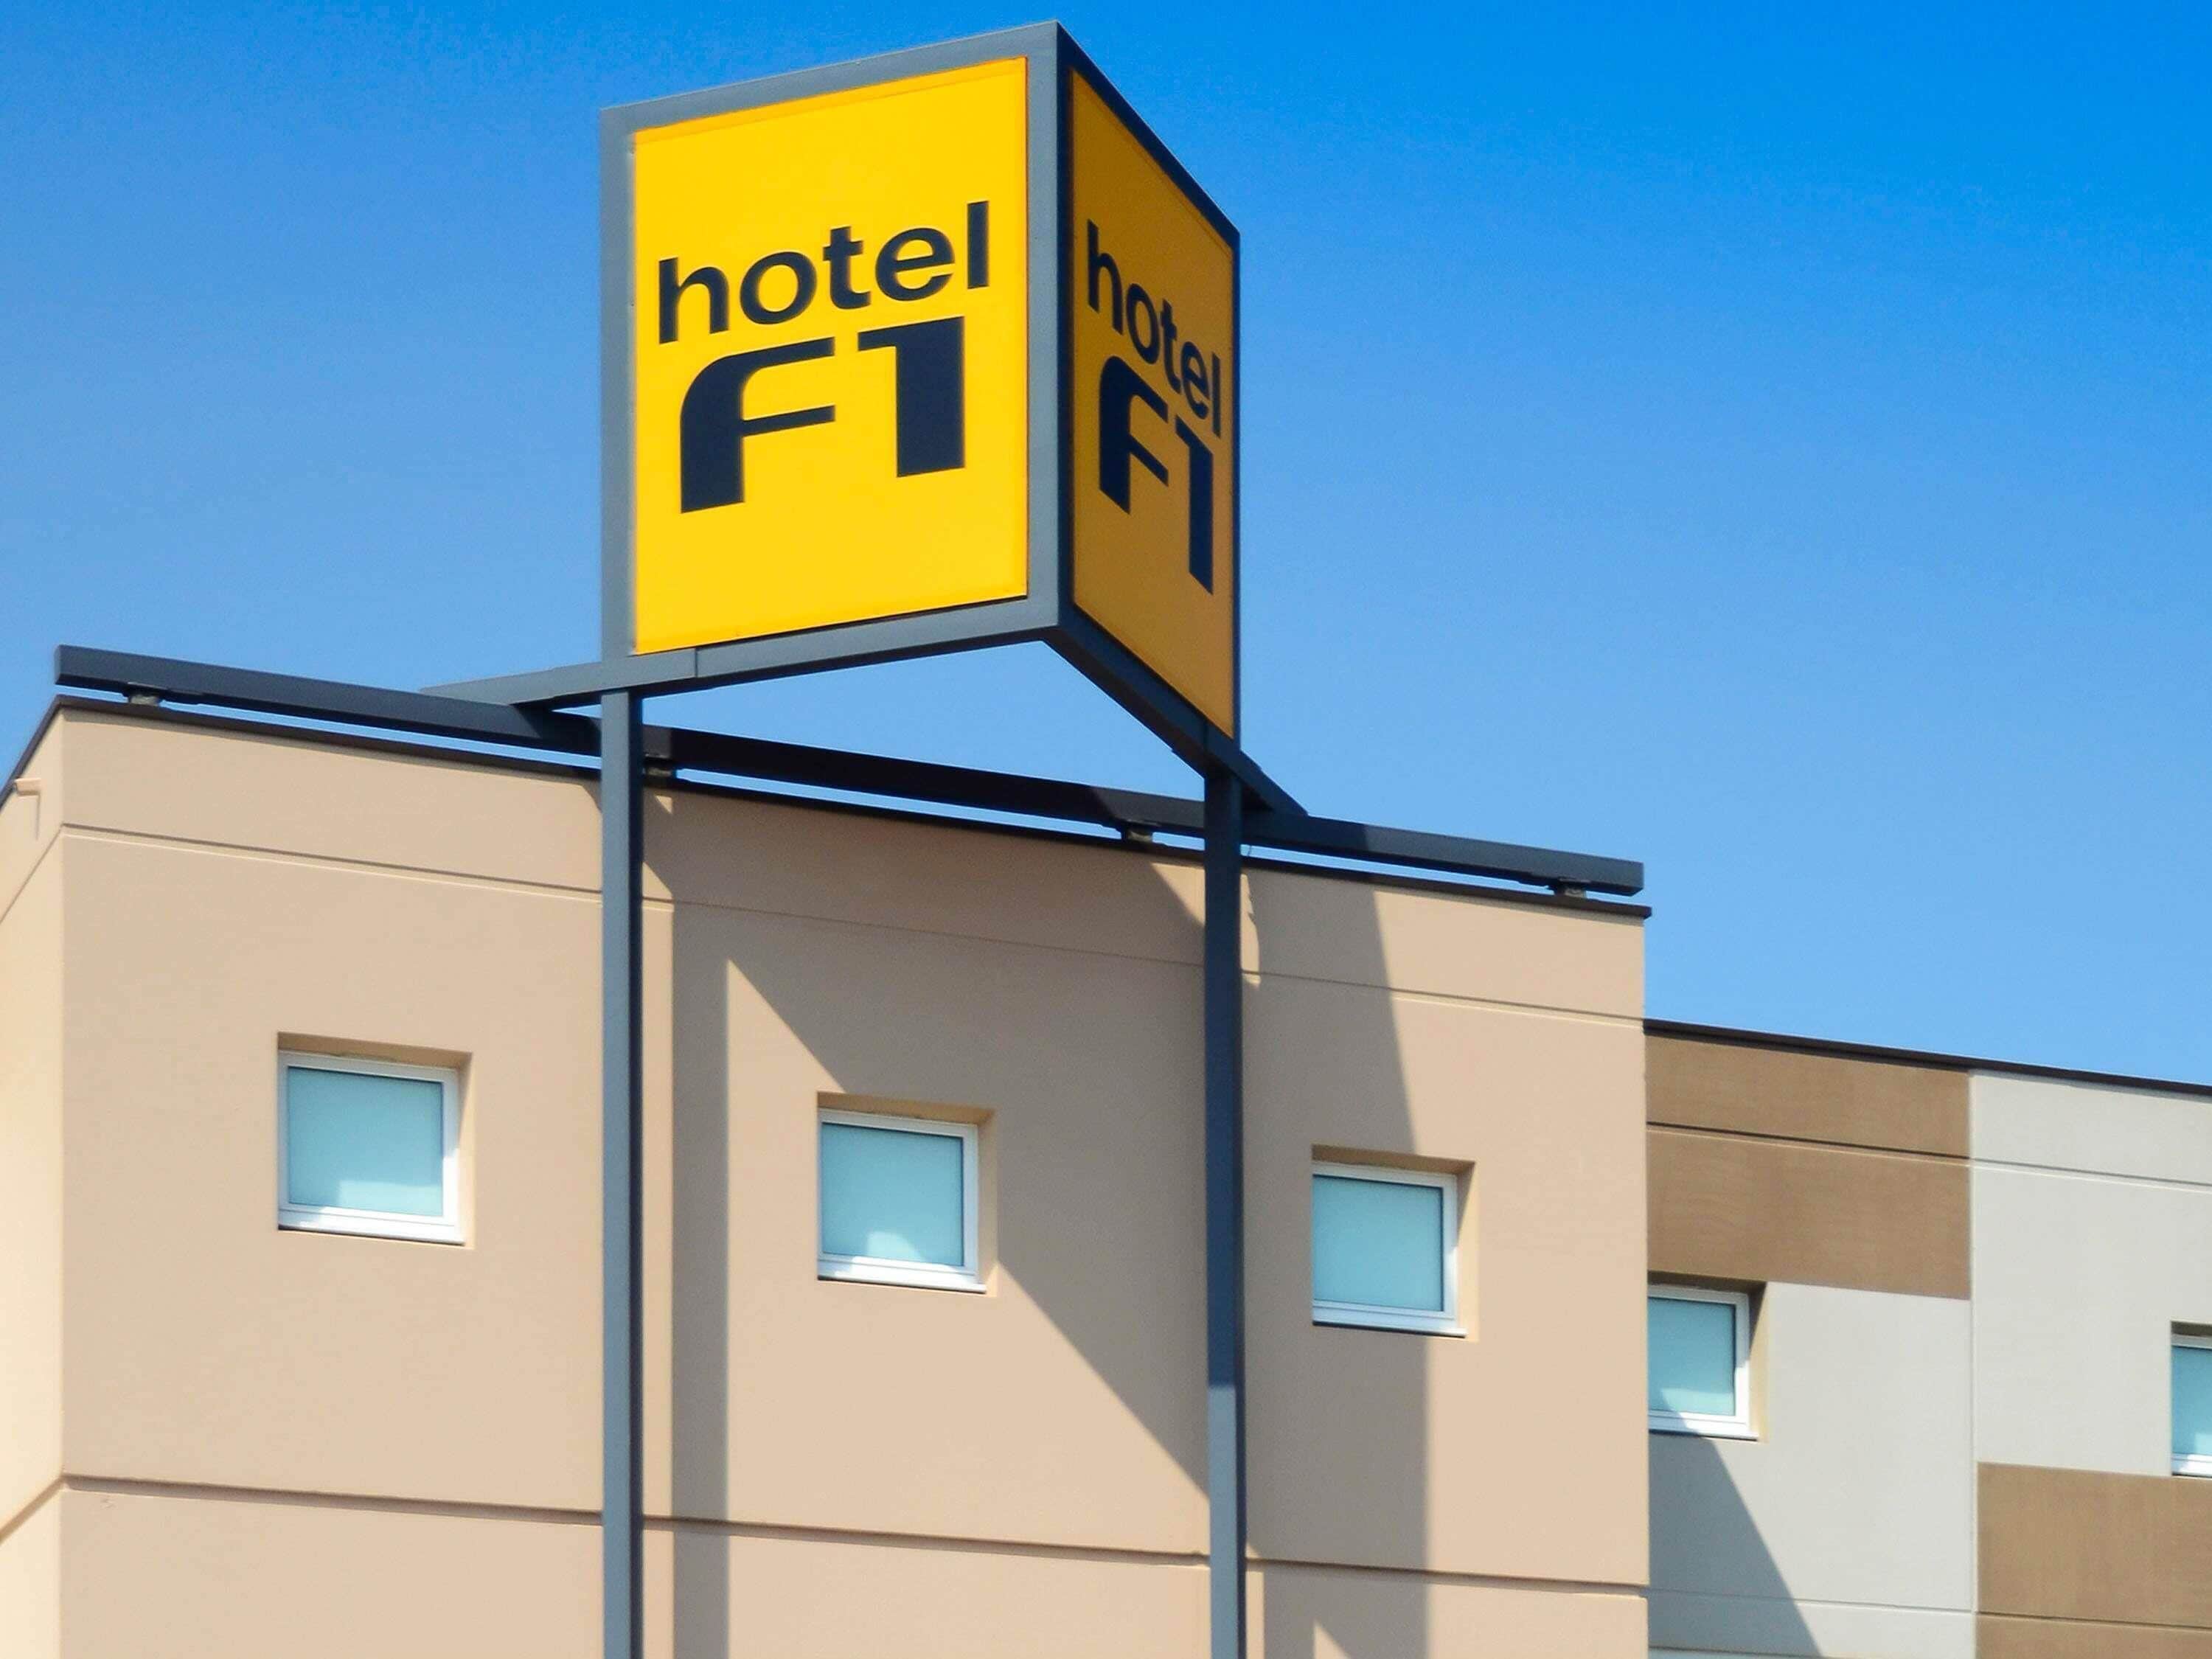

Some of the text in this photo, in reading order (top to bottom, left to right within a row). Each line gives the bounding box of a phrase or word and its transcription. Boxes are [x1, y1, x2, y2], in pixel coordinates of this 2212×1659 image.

[658, 200, 989, 344] hotel
[1087, 219, 1222, 440] hotel
[680, 316, 964, 514] F1
[1098, 355, 1214, 596] F1
